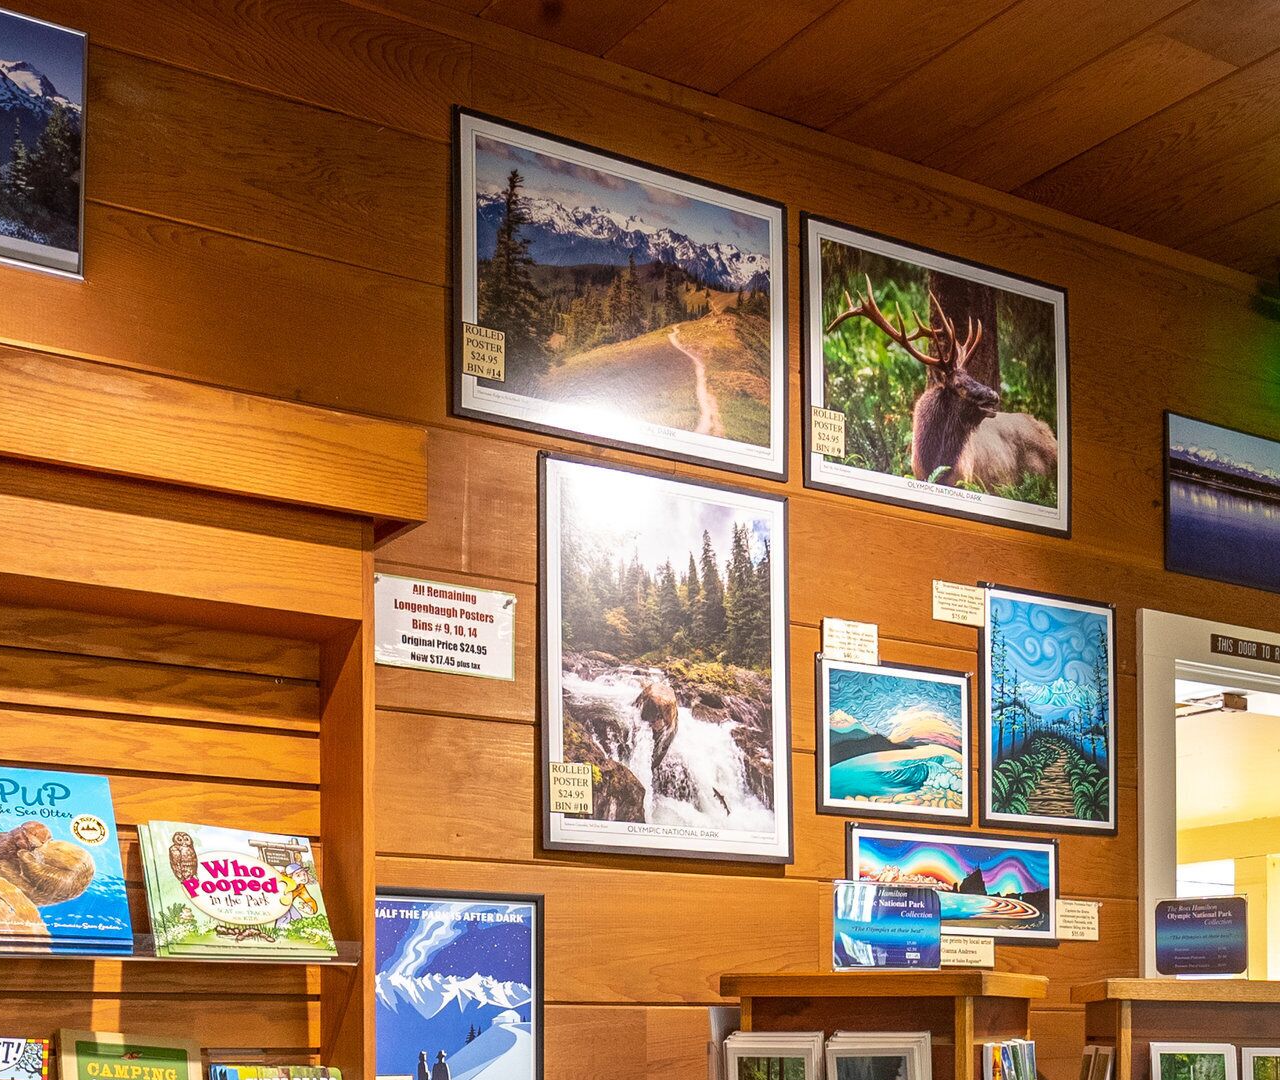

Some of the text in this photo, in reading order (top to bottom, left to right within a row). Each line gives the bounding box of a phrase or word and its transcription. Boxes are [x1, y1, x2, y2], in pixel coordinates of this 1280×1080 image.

[465, 325, 504, 341] ROLLED
[466, 338, 502, 353] POSTER
[471, 351, 498, 364] $24.95
[467, 363, 501, 378] BIN #14
[908, 481, 982, 501] OLYMPIC NATIONAL PARK
[413, 584, 477, 604] All Remaining
[394, 599, 494, 623] Longenbaugh Posters
[412, 619, 477, 638] Bins # 9, 10, 14
[402, 635, 487, 655] Original Price $24.95
[1218, 638, 1233, 652] THIS
[1238, 641, 1256, 656] DOOR
[1262, 645, 1270, 658] TO
[411, 652, 480, 670] Now $17.45 plus tax
[16, 806, 37, 818] Sea
[40, 808, 73, 820] Otter
[200, 859, 265, 879] Who
[182, 877, 280, 898] Pooped
[209, 894, 270, 907] in the Park
[399, 909, 523, 923] THE AFTER DARK
